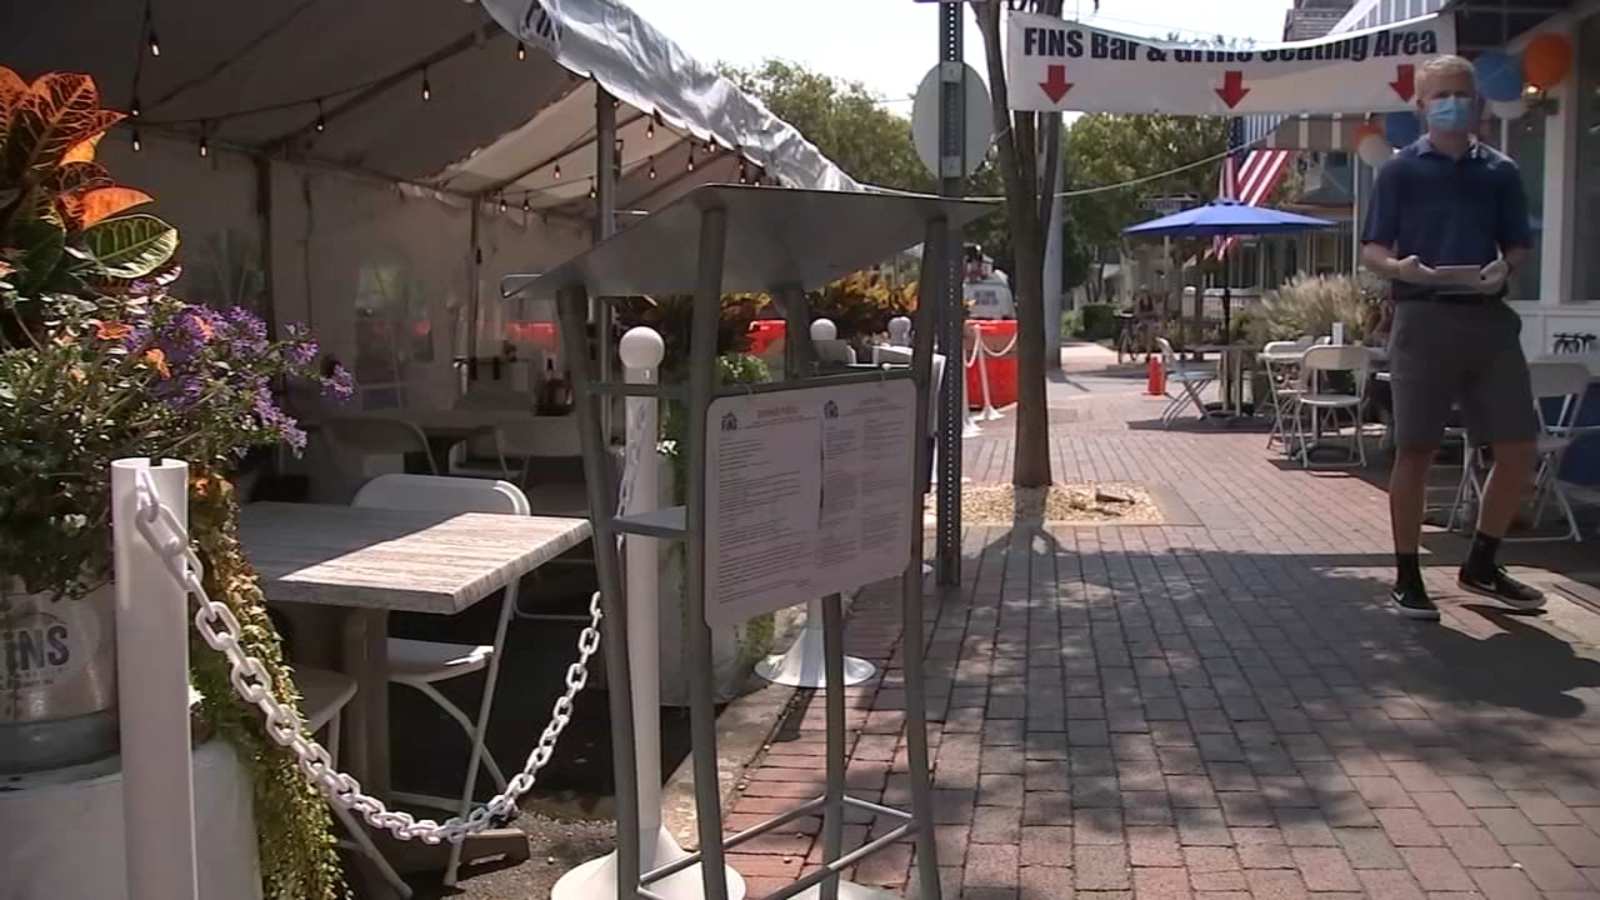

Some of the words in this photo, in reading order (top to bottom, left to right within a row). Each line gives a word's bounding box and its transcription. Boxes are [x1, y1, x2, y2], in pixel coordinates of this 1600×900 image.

[1024, 27, 1083, 57] FINS
[1090, 31, 1139, 60] Bar
[1373, 29, 1437, 56] Area
